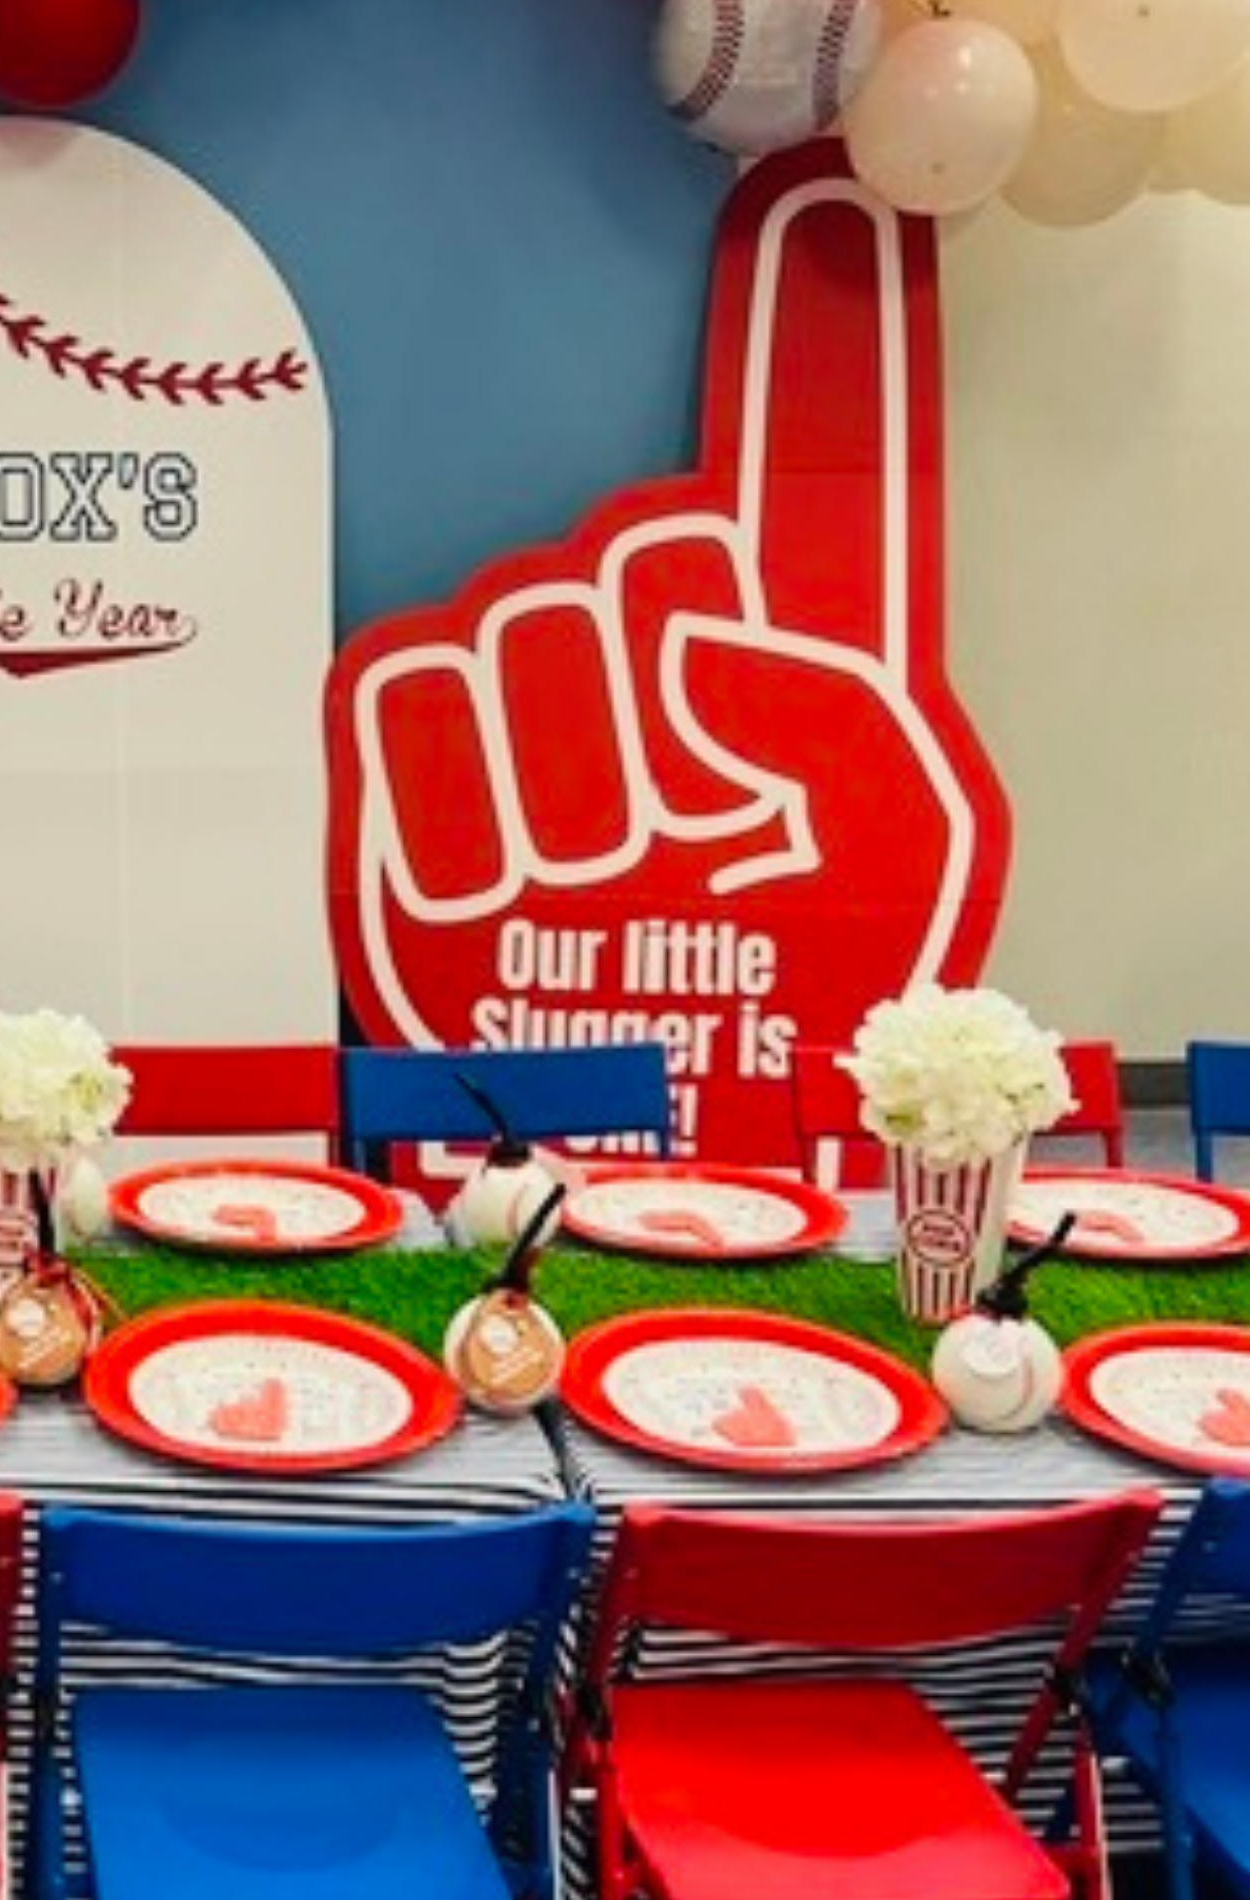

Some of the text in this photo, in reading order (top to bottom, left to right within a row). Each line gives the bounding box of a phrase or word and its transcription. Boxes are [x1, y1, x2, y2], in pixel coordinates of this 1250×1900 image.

[53, 576, 198, 642] Year
[497, 918, 777, 995] Our little
[737, 998, 799, 1078] is
